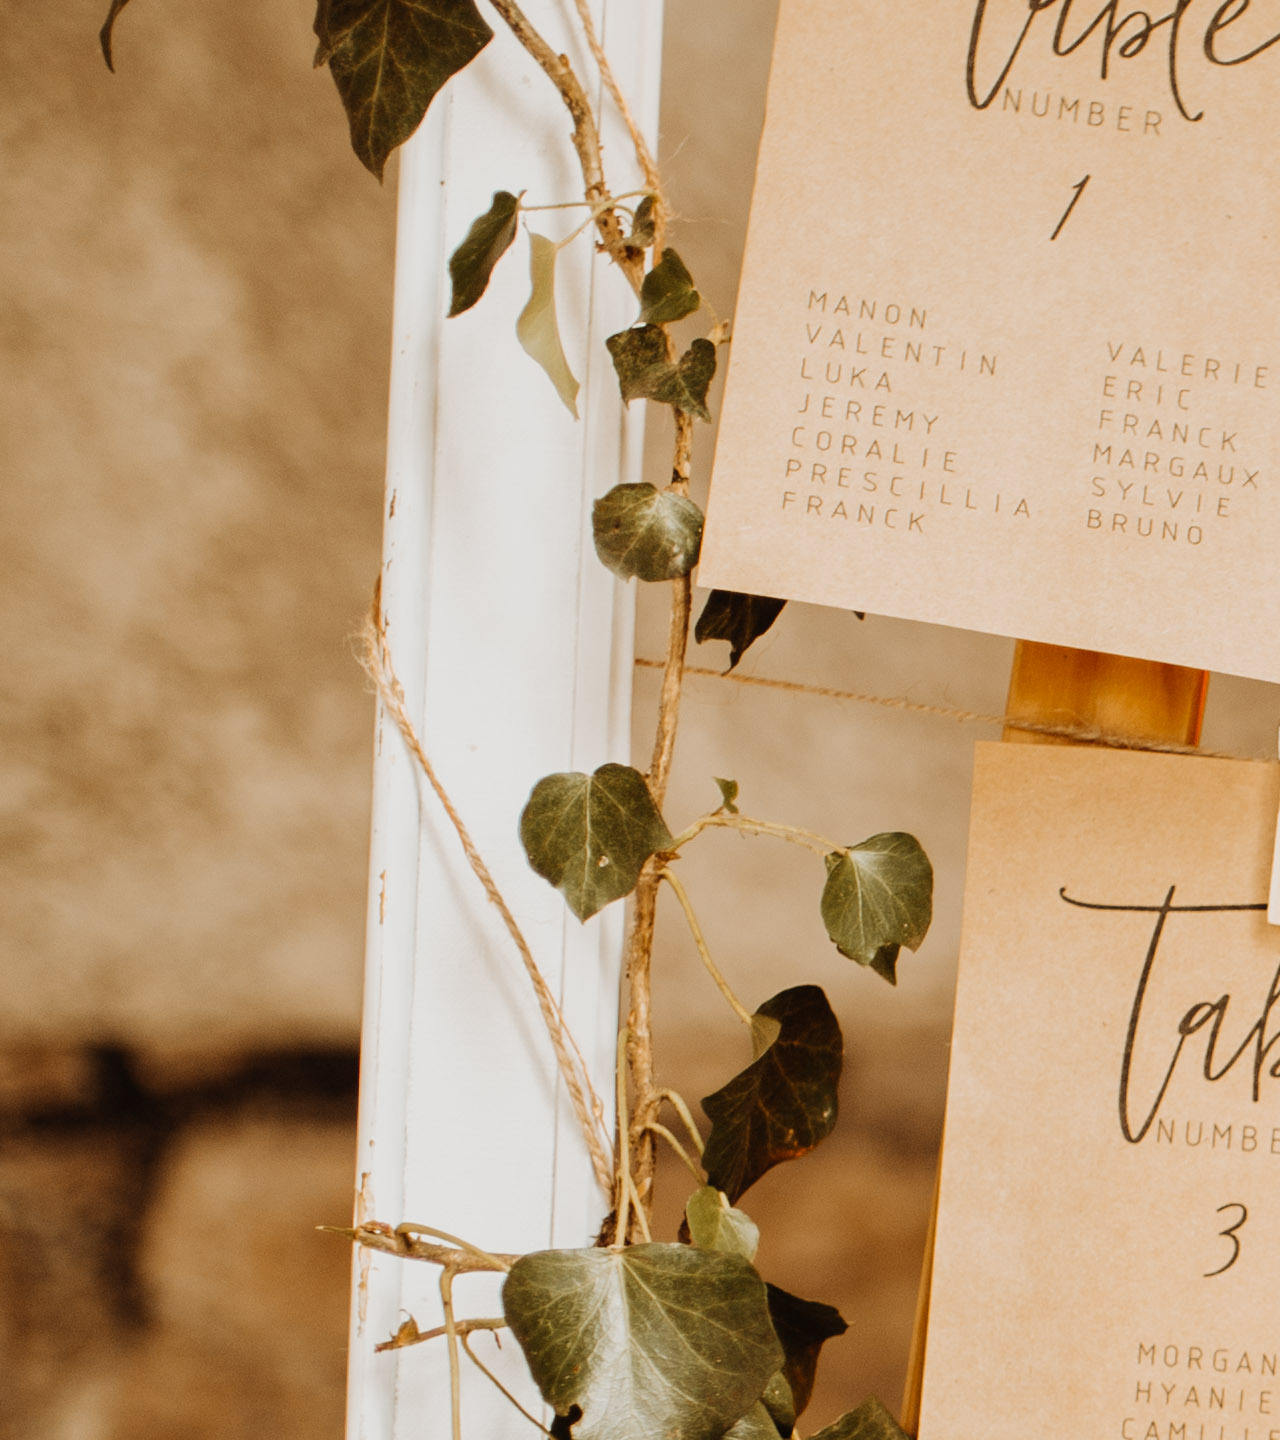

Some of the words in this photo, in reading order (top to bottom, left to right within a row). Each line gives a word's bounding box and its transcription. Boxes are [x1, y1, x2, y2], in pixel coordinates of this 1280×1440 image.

[1003, 87, 1164, 137] NUMBER
[1050, 174, 1090, 242] 1
[808, 290, 927, 330] MANON
[806, 324, 997, 376] VALENTIN
[1107, 342, 1268, 389] VALERIE
[800, 358, 892, 393] LUKA
[1103, 375, 1190, 411] ERIC
[798, 394, 939, 434] JEREMY
[1099, 409, 1237, 453] FRANCK
[792, 426, 956, 474] CORALIE
[1093, 443, 1259, 489] MARGAUX
[785, 458, 1030, 518] PRESCILLIA
[1092, 476, 1230, 518] SYLVIE
[781, 491, 925, 533] FRANCK
[1087, 509, 1203, 546] BRUNO
[1204, 1202, 1248, 1279] 3
[1138, 1342, 1278, 1376] MORGAN
[1135, 1381, 1272, 1415] HYANIE
